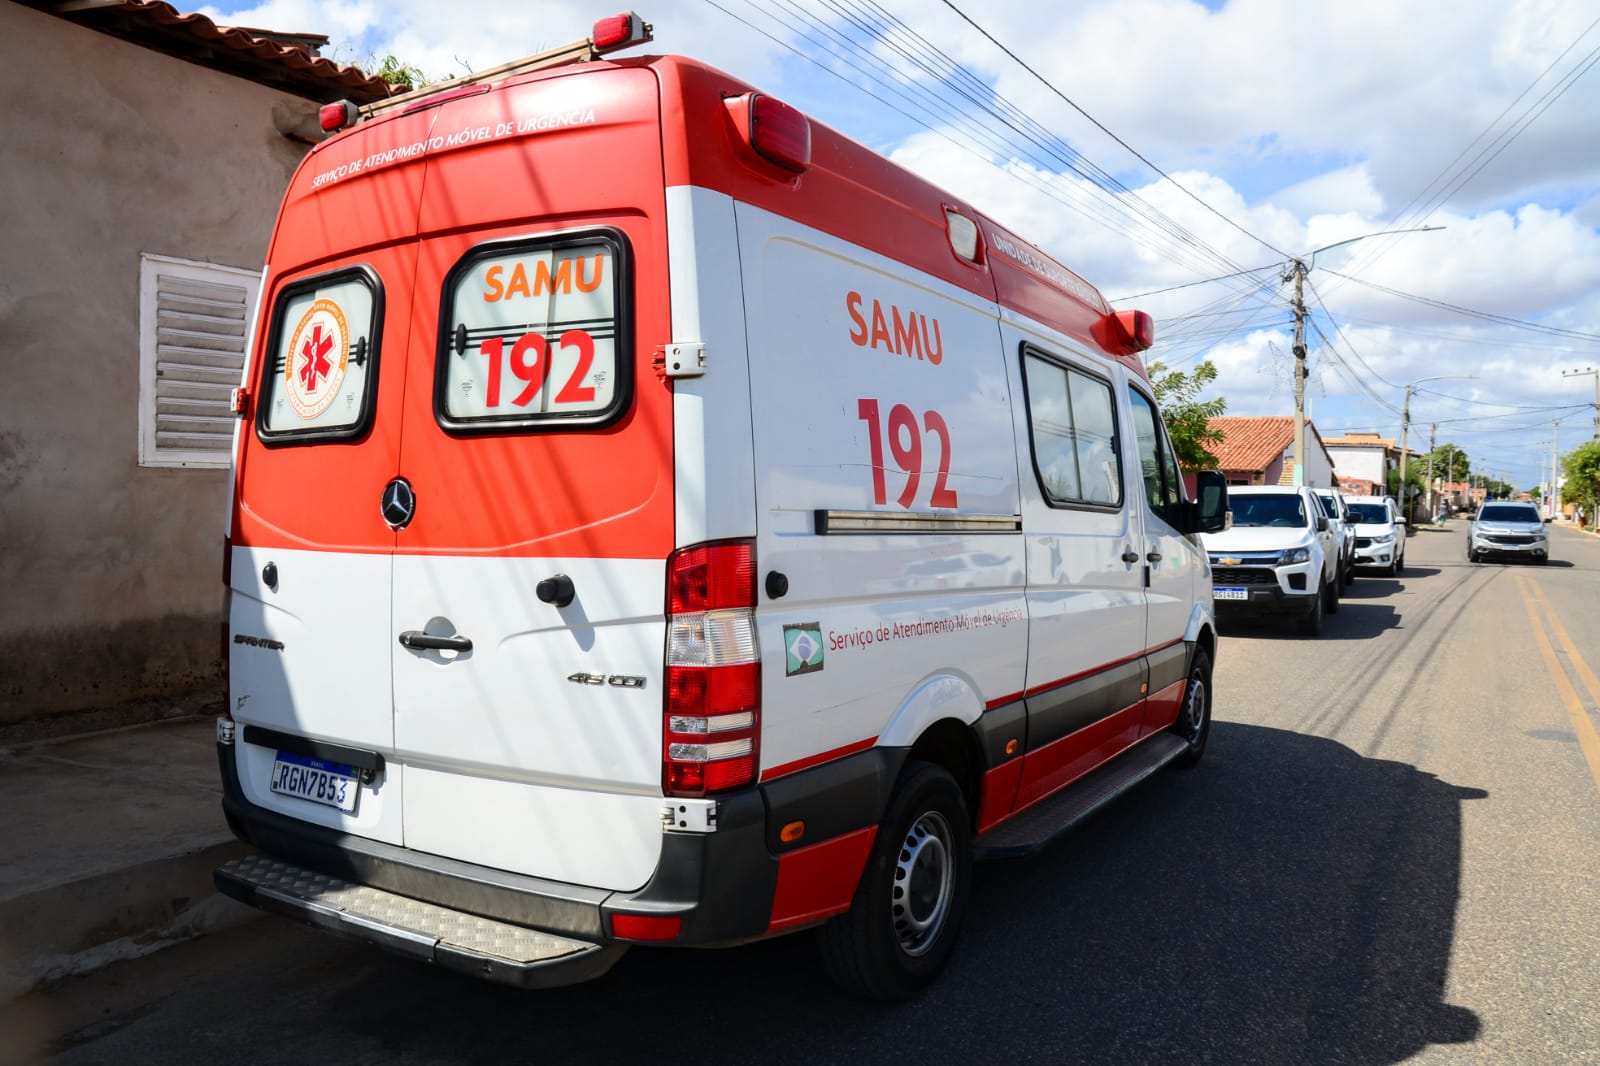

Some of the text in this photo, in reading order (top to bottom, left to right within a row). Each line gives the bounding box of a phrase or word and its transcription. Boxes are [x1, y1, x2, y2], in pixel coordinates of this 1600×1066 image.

[312, 167, 347, 189] SERVIÇO
[348, 160, 362, 175] DE
[363, 138, 444, 169] ATENDIMENTO
[445, 127, 492, 147] MÓVEL
[495, 121, 514, 138] DE
[484, 254, 604, 302] SAMU
[846, 290, 943, 366] SAMU
[480, 329, 597, 408] 192
[857, 398, 958, 510] 192
[829, 628, 873, 651] Serviço
[876, 623, 890, 642] de
[893, 617, 955, 641] Atendimento
[956, 609, 982, 632] Móvel
[982, 608, 993, 627] de
[279, 764, 348, 804] RGN7B53
